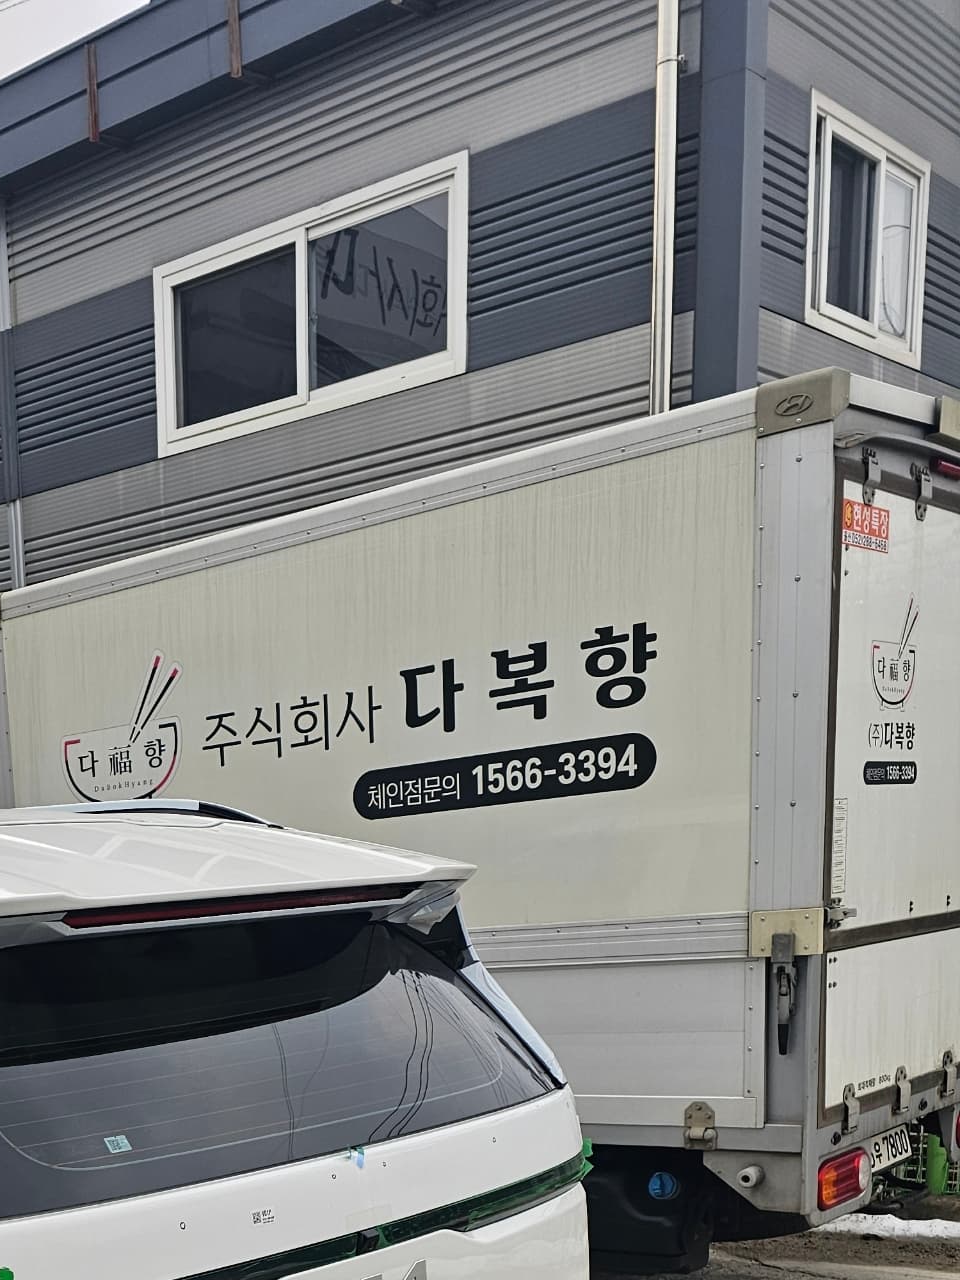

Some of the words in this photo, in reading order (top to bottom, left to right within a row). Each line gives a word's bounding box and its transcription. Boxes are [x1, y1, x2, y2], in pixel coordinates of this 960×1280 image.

[201, 685, 382, 767] 주식회사
[367, 772, 461, 811] 체인점문의
[471, 742, 639, 795] 1566-3394
[882, 1129, 909, 1161] 7800
